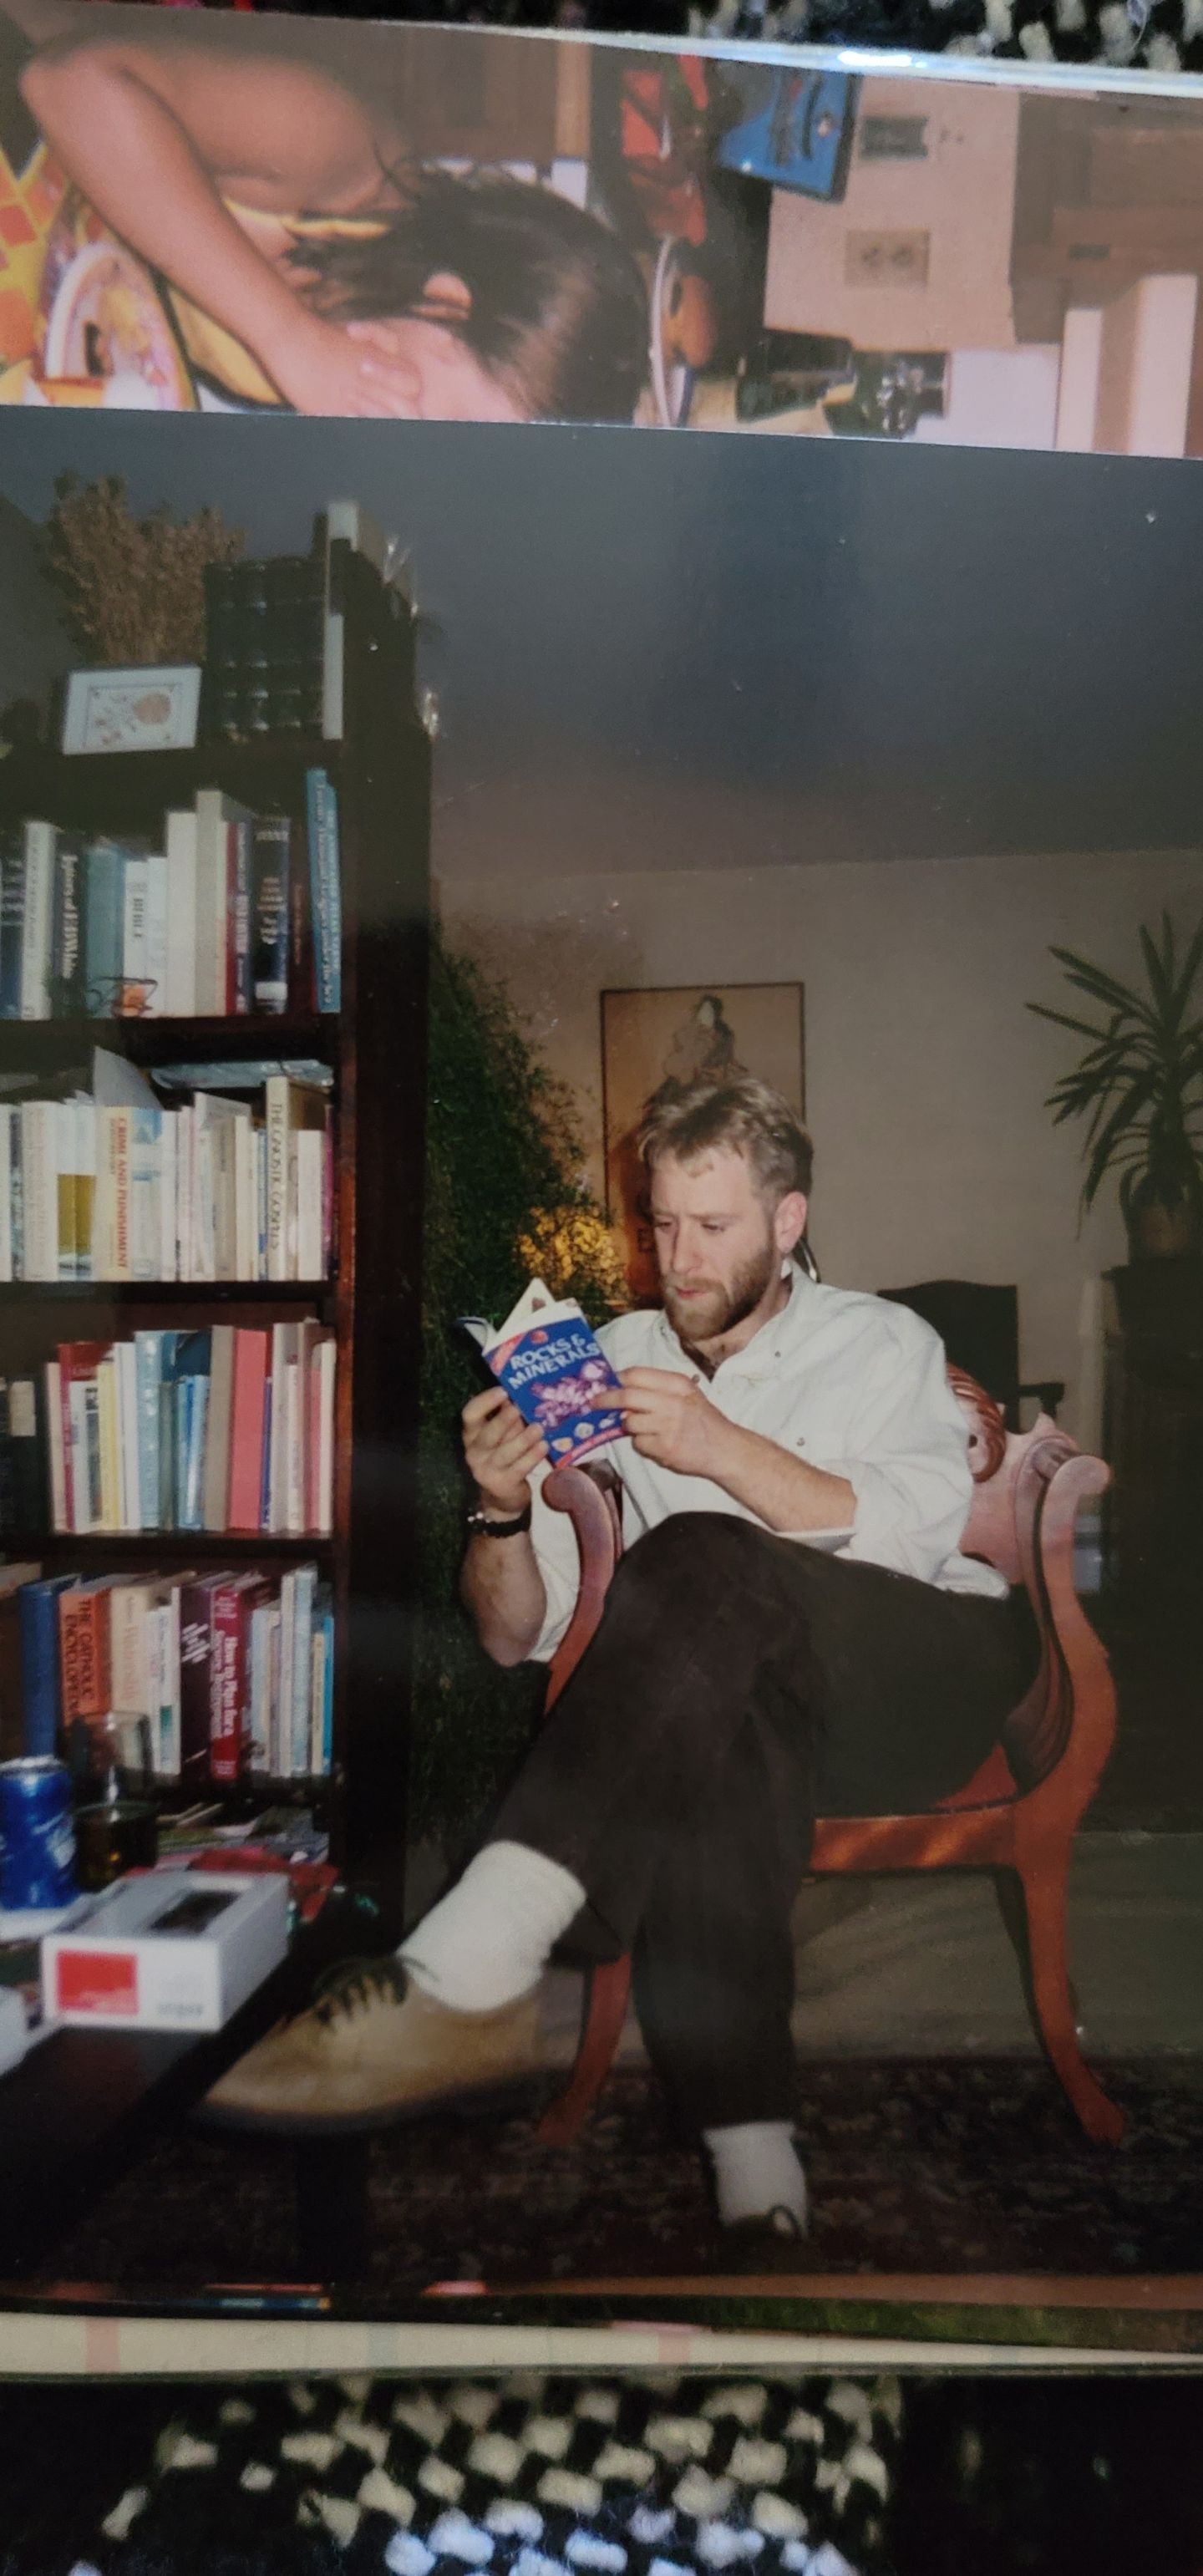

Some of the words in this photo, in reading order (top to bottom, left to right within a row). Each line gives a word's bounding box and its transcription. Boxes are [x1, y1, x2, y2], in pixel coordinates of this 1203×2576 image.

[272, 1103, 282, 1125] THE
[117, 1118, 128, 1156] CRIME
[116, 1158, 128, 1186] AND
[271, 1130, 282, 1183] GNOSTIC
[114, 1189, 128, 1268] PUNISHMENT
[507, 1342, 602, 1390] MINERALS
[510, 1336, 572, 1371] ROCKS
[570, 1333, 586, 1347] &
[80, 1599, 93, 1626] THE
[225, 1636, 238, 1663] How
[81, 1633, 96, 1700] CATHOLIC
[224, 1665, 237, 1679] to
[224, 1709, 238, 1725] for
